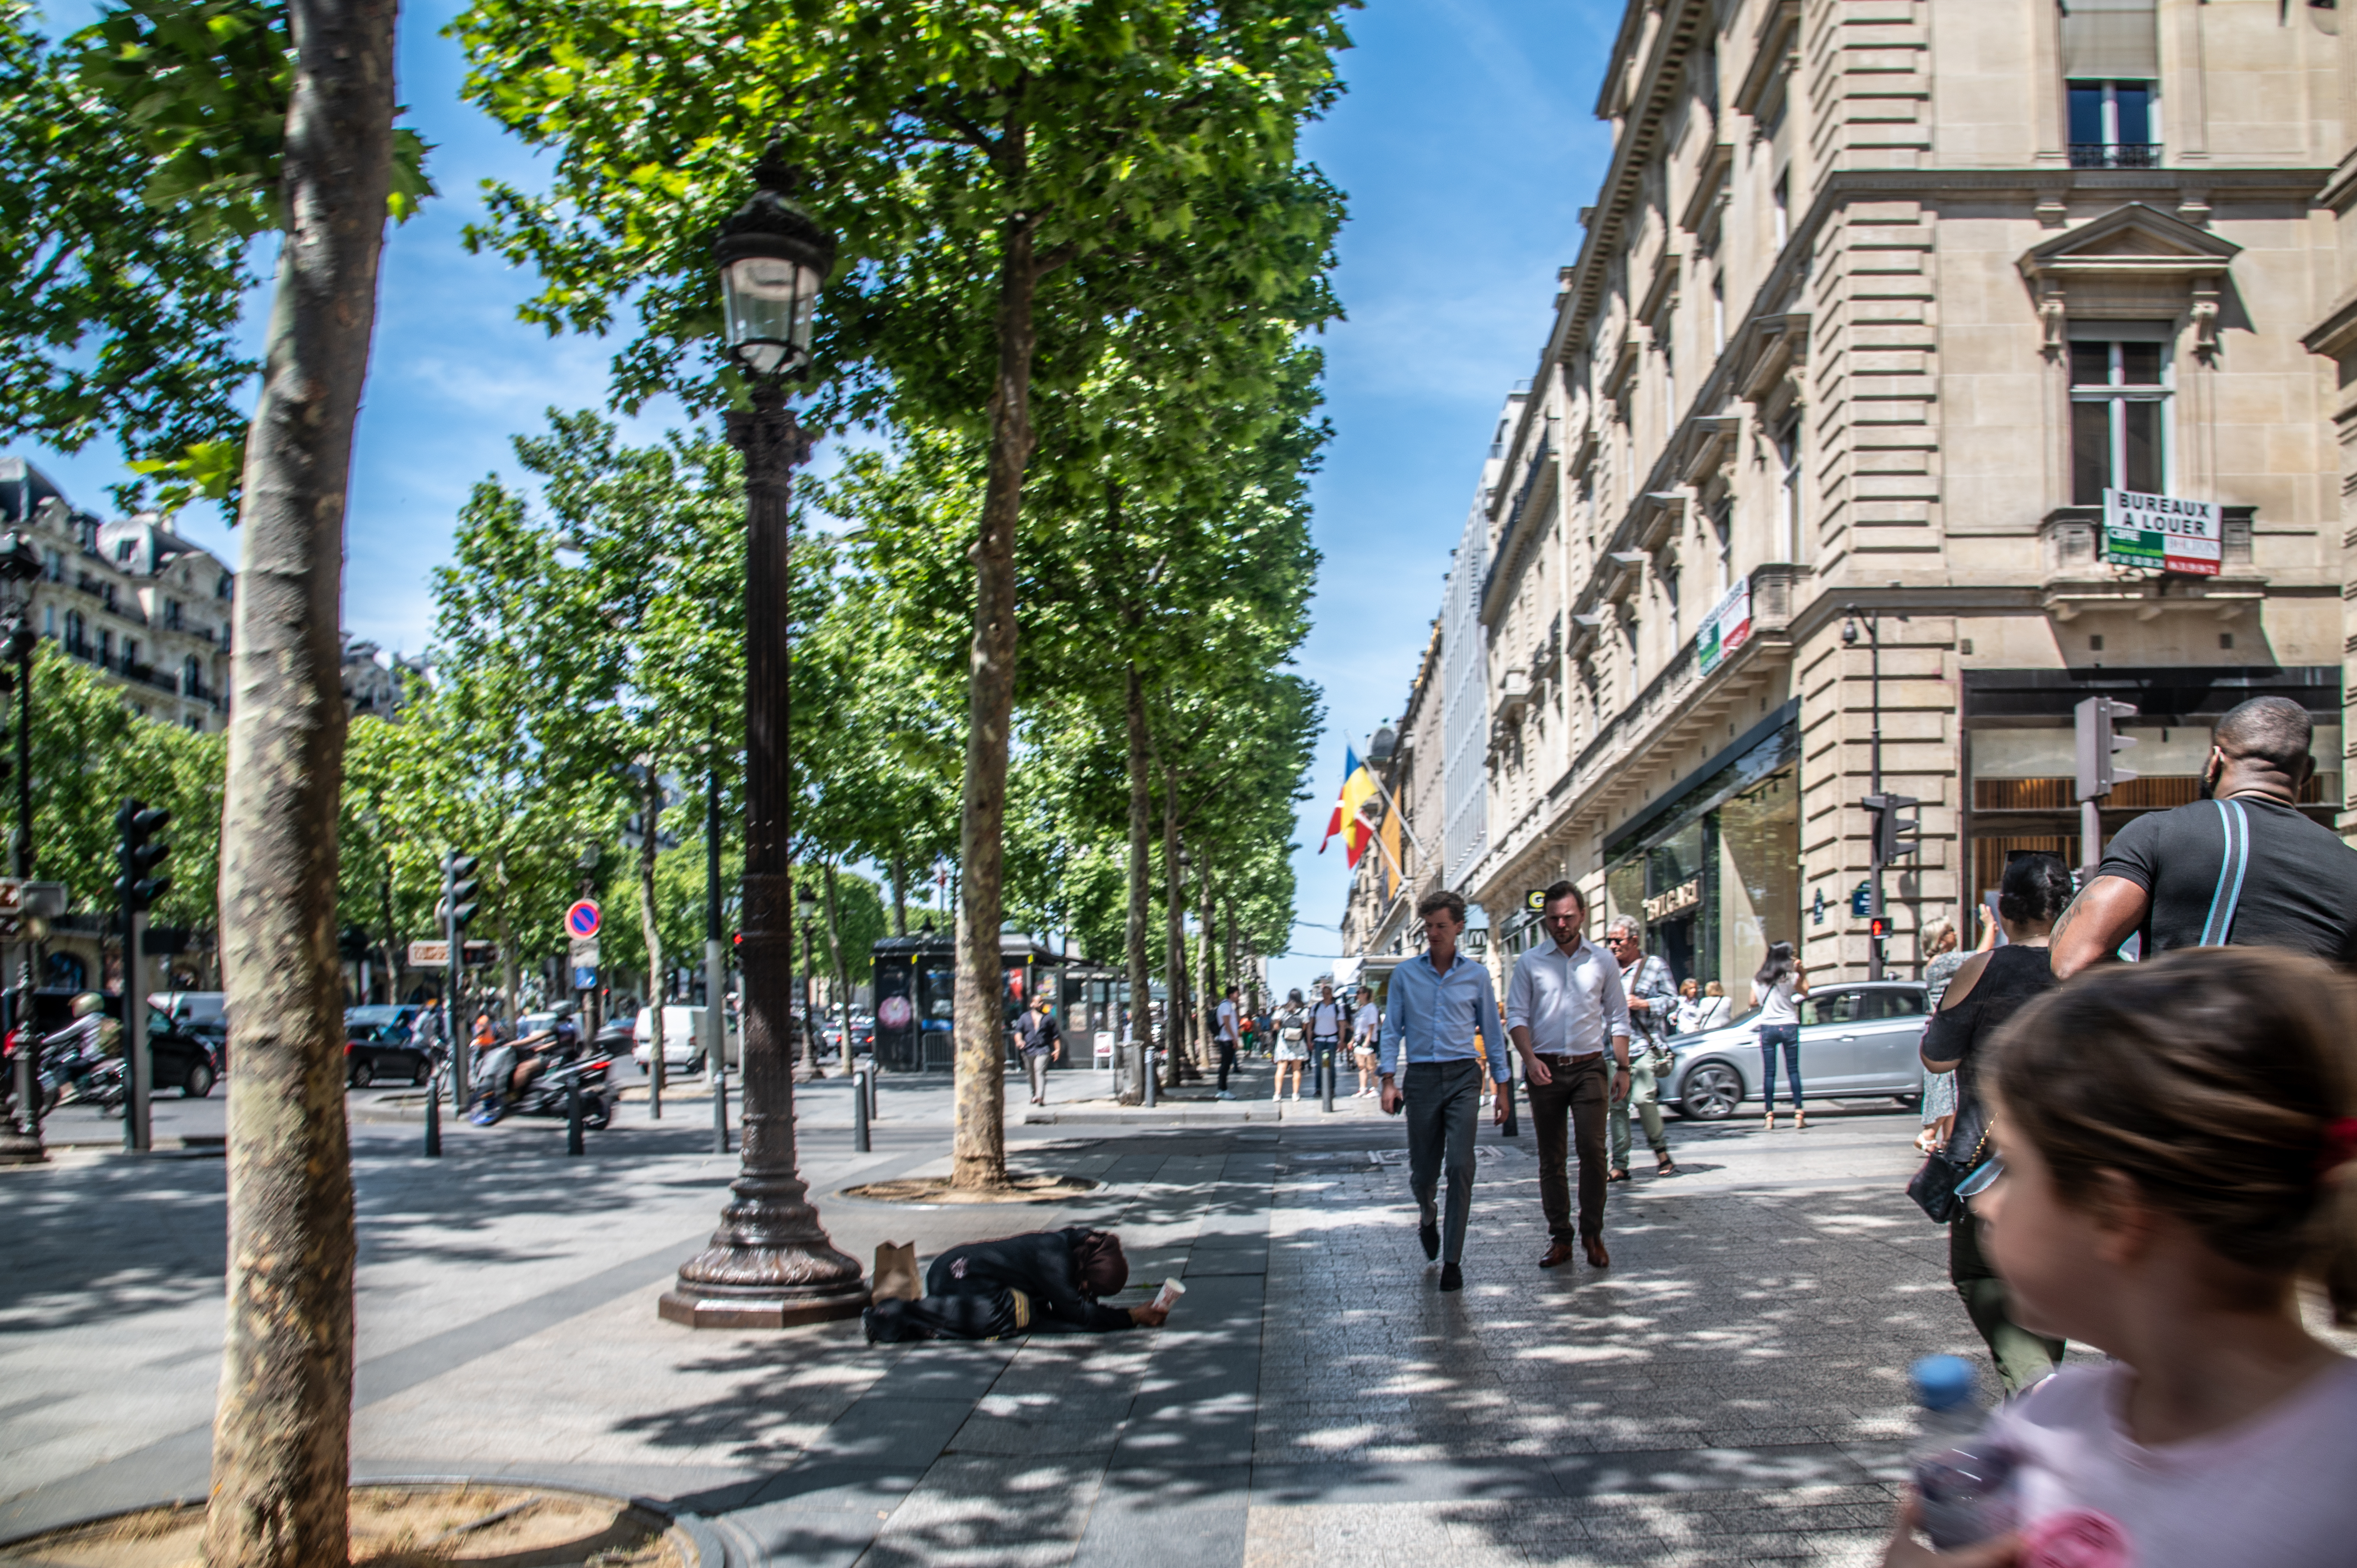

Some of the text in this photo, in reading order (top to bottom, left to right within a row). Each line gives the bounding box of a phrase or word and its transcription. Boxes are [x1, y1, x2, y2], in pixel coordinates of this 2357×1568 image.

[2119, 493, 2209, 518] BUREAUX
[2123, 512, 2206, 535] A LOUER
